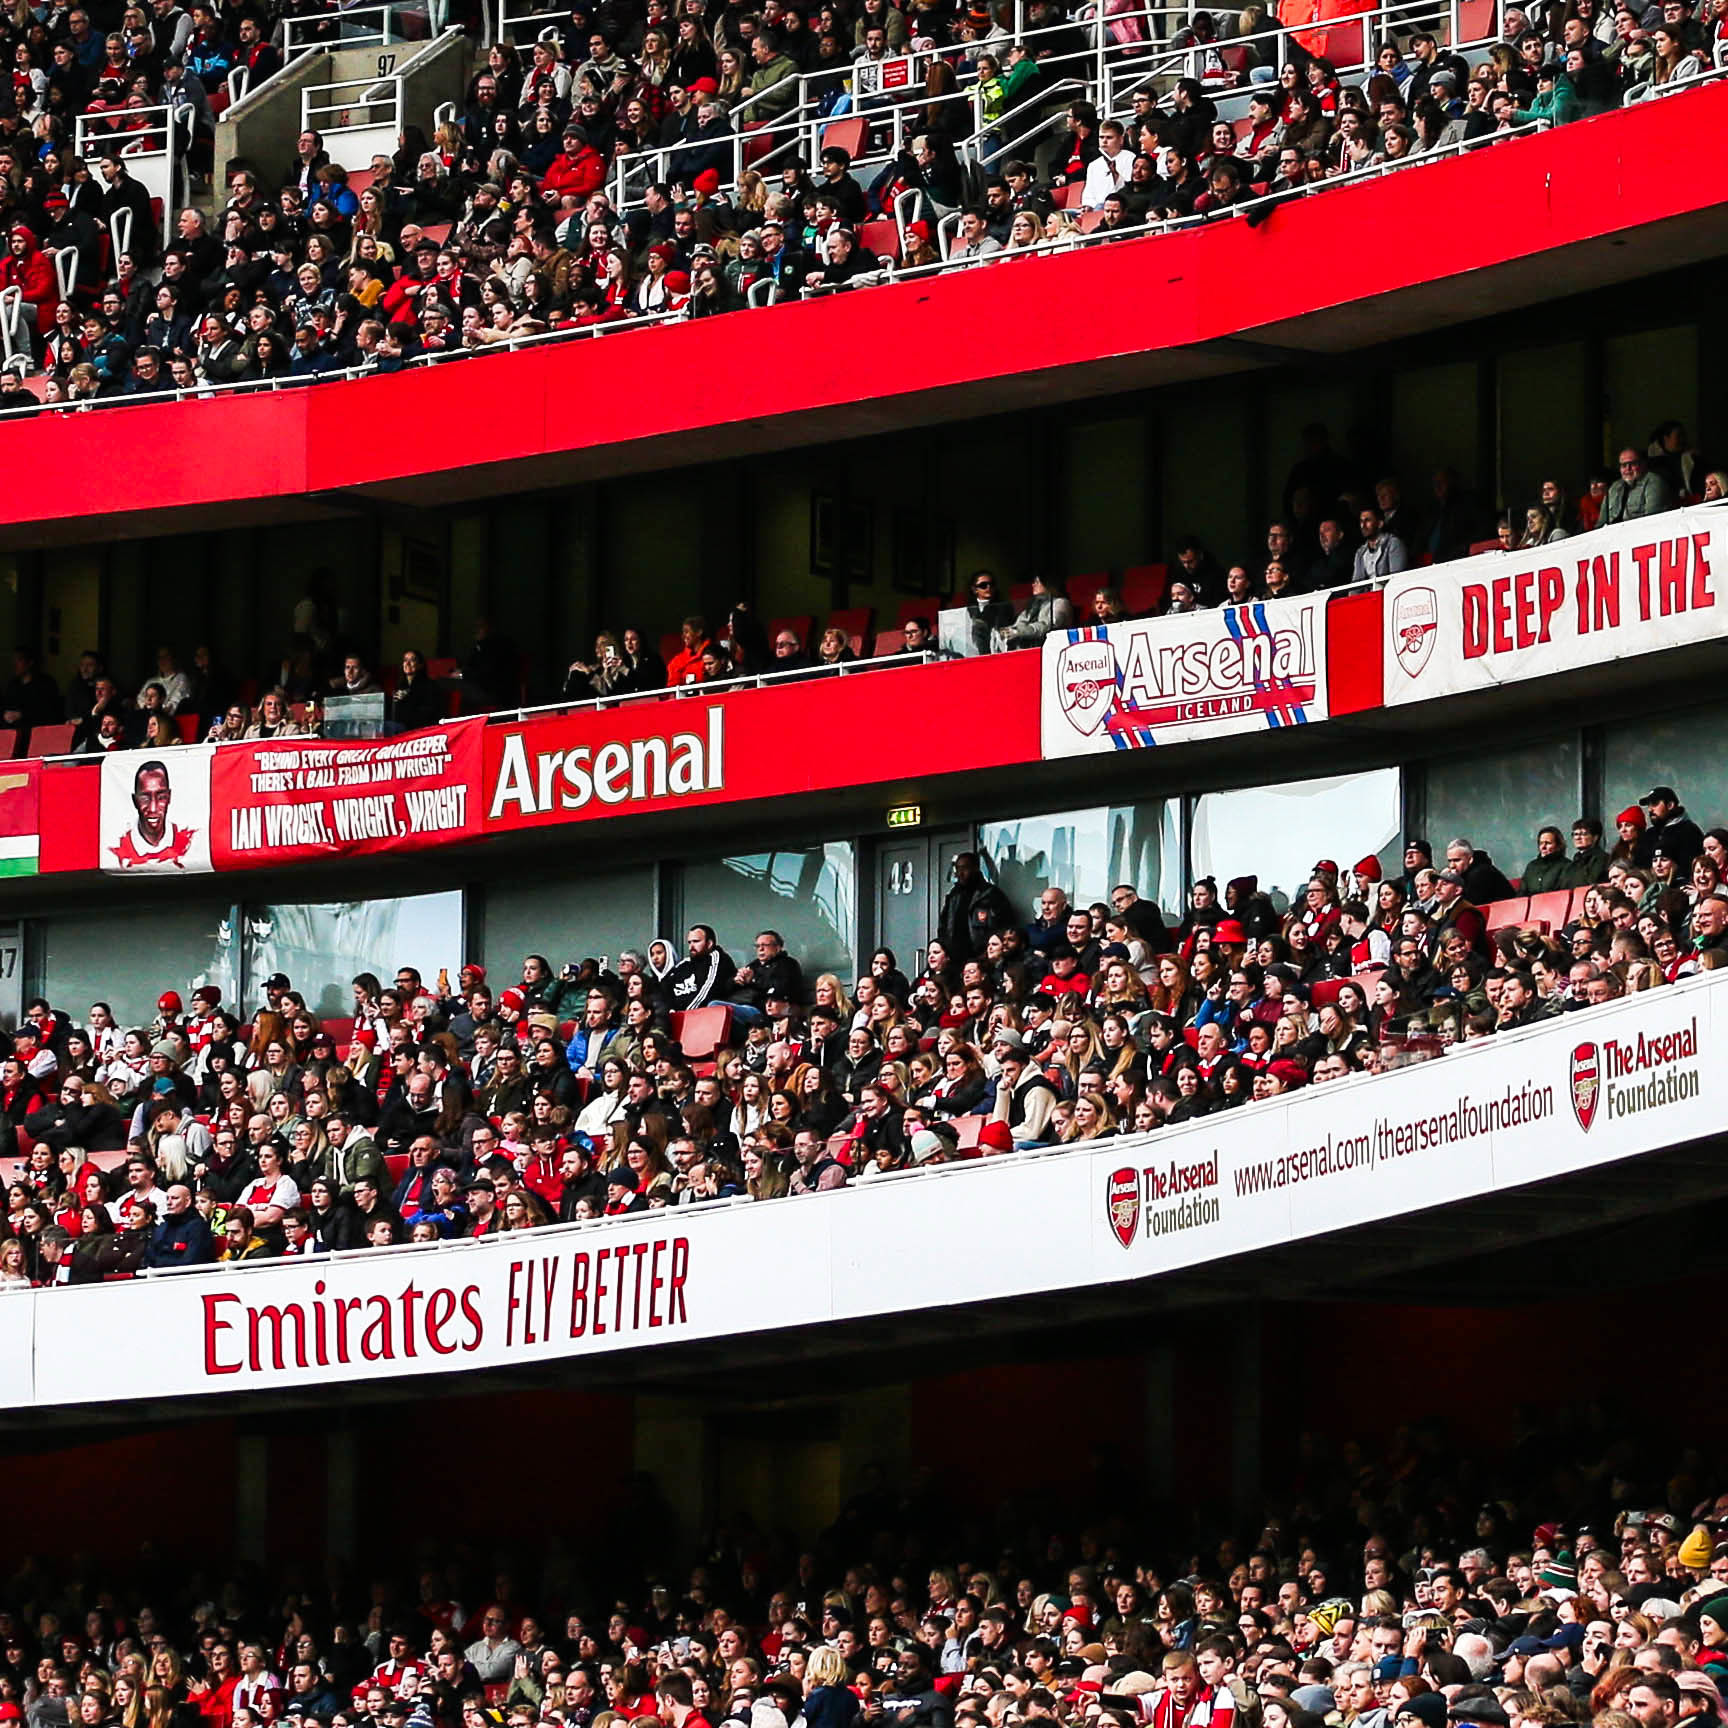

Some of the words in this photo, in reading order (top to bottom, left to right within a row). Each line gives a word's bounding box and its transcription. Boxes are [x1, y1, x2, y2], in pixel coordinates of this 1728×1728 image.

[378, 54, 396, 77] 97
[1461, 567, 1564, 660] DEEP
[1575, 553, 1621, 635] IN
[1631, 530, 1716, 621] THE
[1066, 656, 1108, 673] Arsenal
[1121, 606, 1315, 702] Arsenal
[1176, 695, 1253, 720] ICELAND
[296, 773, 305, 789] A
[306, 768, 337, 788] BALL
[337, 764, 370, 786] FROM
[371, 762, 394, 781] IAN
[302, 749, 340, 768] EVERY
[488, 705, 726, 820] Arsenal
[231, 807, 262, 850] IAN
[264, 802, 334, 847] WRIGHT,
[404, 785, 468, 833] WRIGHT
[1603, 1039, 1634, 1080] The
[1635, 1016, 1698, 1072] Arsenal
[1607, 1064, 1699, 1120] Foundation
[1233, 1080, 1554, 1198] www.arsenal.com/thearsenalfoundation
[1143, 1166, 1167, 1202] The
[1168, 1149, 1218, 1197] Arsenal
[1145, 1192, 1220, 1238] Foundation
[200, 1278, 484, 1376] Emirates
[505, 1255, 559, 1347] FLY
[570, 1237, 689, 1339] BETTER
